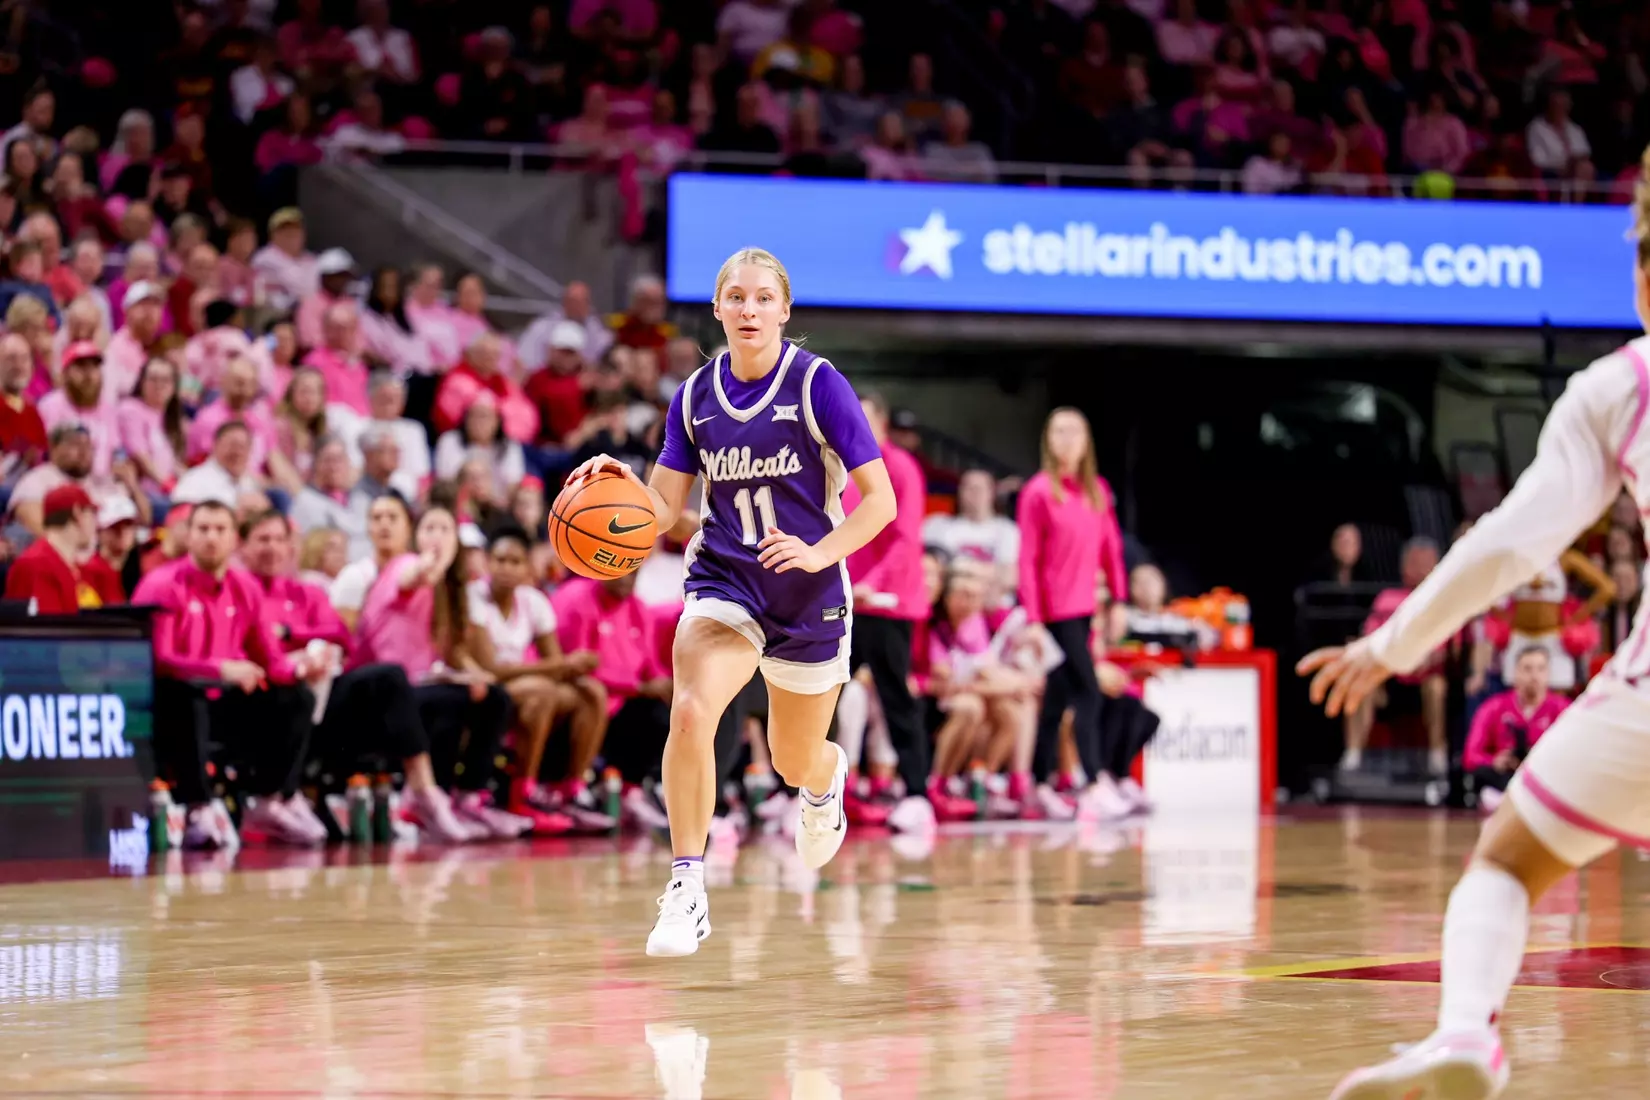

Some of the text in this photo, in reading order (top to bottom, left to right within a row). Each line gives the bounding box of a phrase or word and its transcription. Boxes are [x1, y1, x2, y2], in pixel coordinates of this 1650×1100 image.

[983, 223, 1542, 289] stellarindustries.com
[699, 444, 803, 481] Wildcats
[733, 485, 778, 546] 11
[593, 548, 644, 569] ELITE
